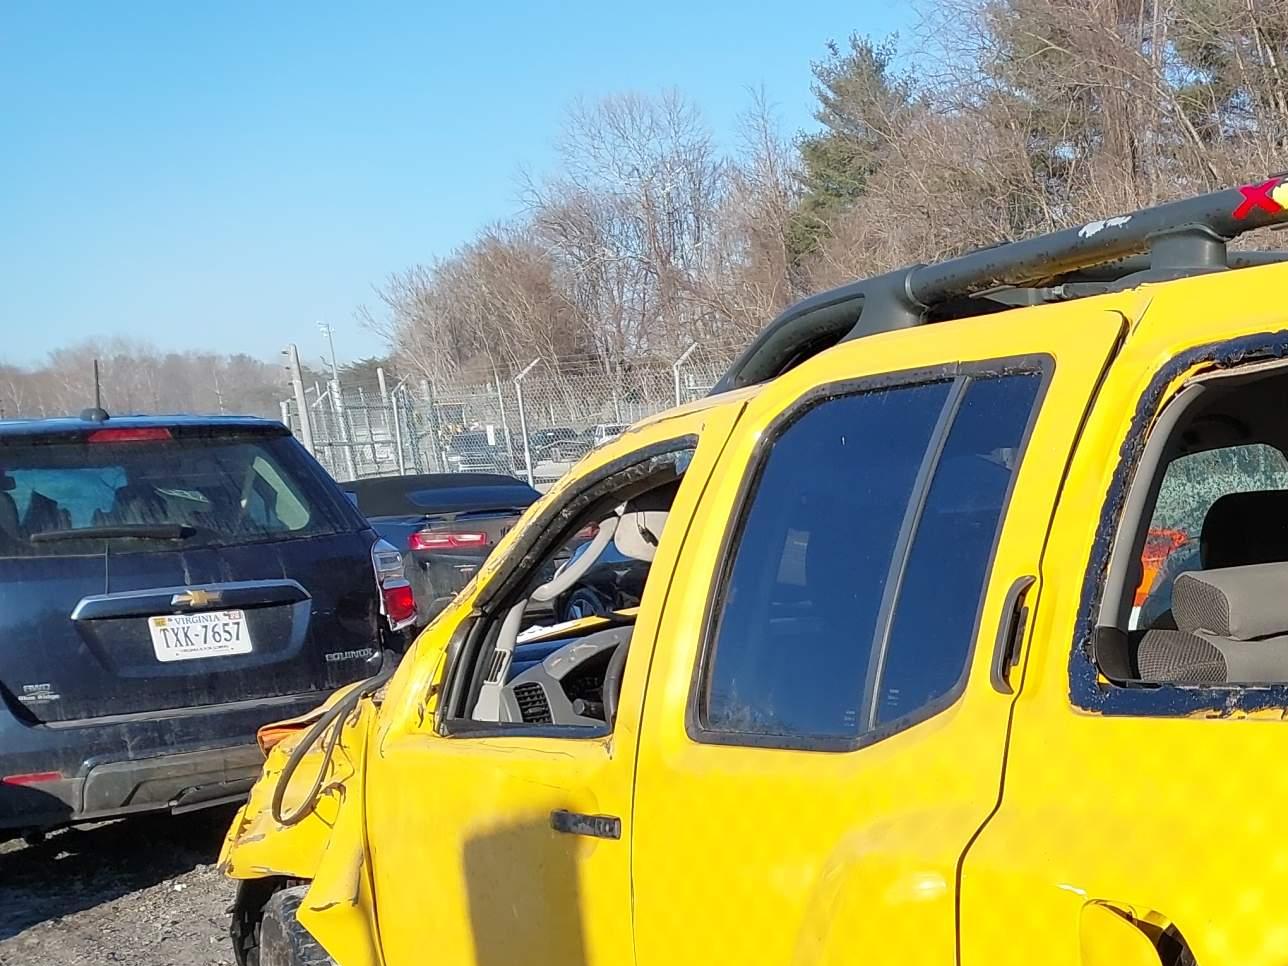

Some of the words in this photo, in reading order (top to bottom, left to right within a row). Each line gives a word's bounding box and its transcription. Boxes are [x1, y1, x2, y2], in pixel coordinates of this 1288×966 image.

[174, 614, 221, 625] VIRGINIA
[160, 621, 241, 649] TXK-7657
[324, 647, 374, 662] EQUINOX
